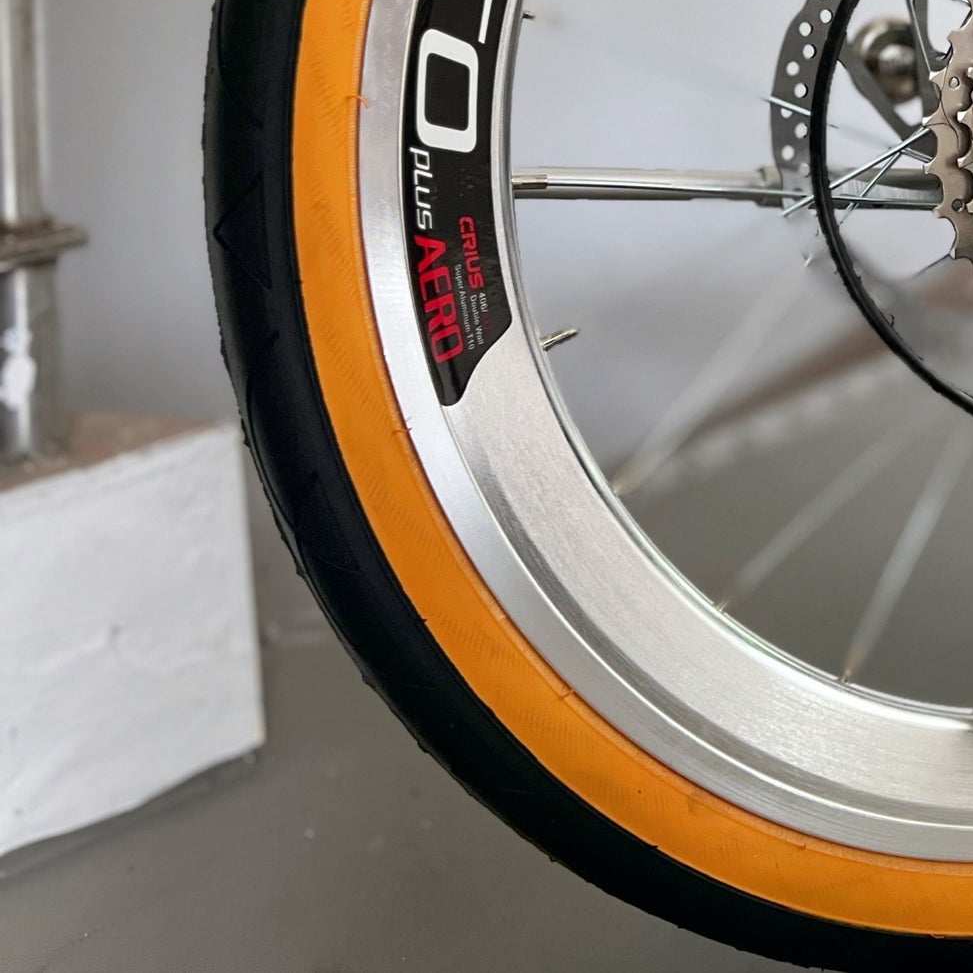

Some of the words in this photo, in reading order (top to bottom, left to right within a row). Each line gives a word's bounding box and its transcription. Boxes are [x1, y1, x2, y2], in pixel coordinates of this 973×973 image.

[457, 215, 485, 289] CRIUS
[453, 263, 464, 289] Super
[413, 234, 465, 364] AERO
[457, 290, 472, 332] Aluminum
[469, 294, 481, 325] Double
[474, 325, 484, 345] Wall
